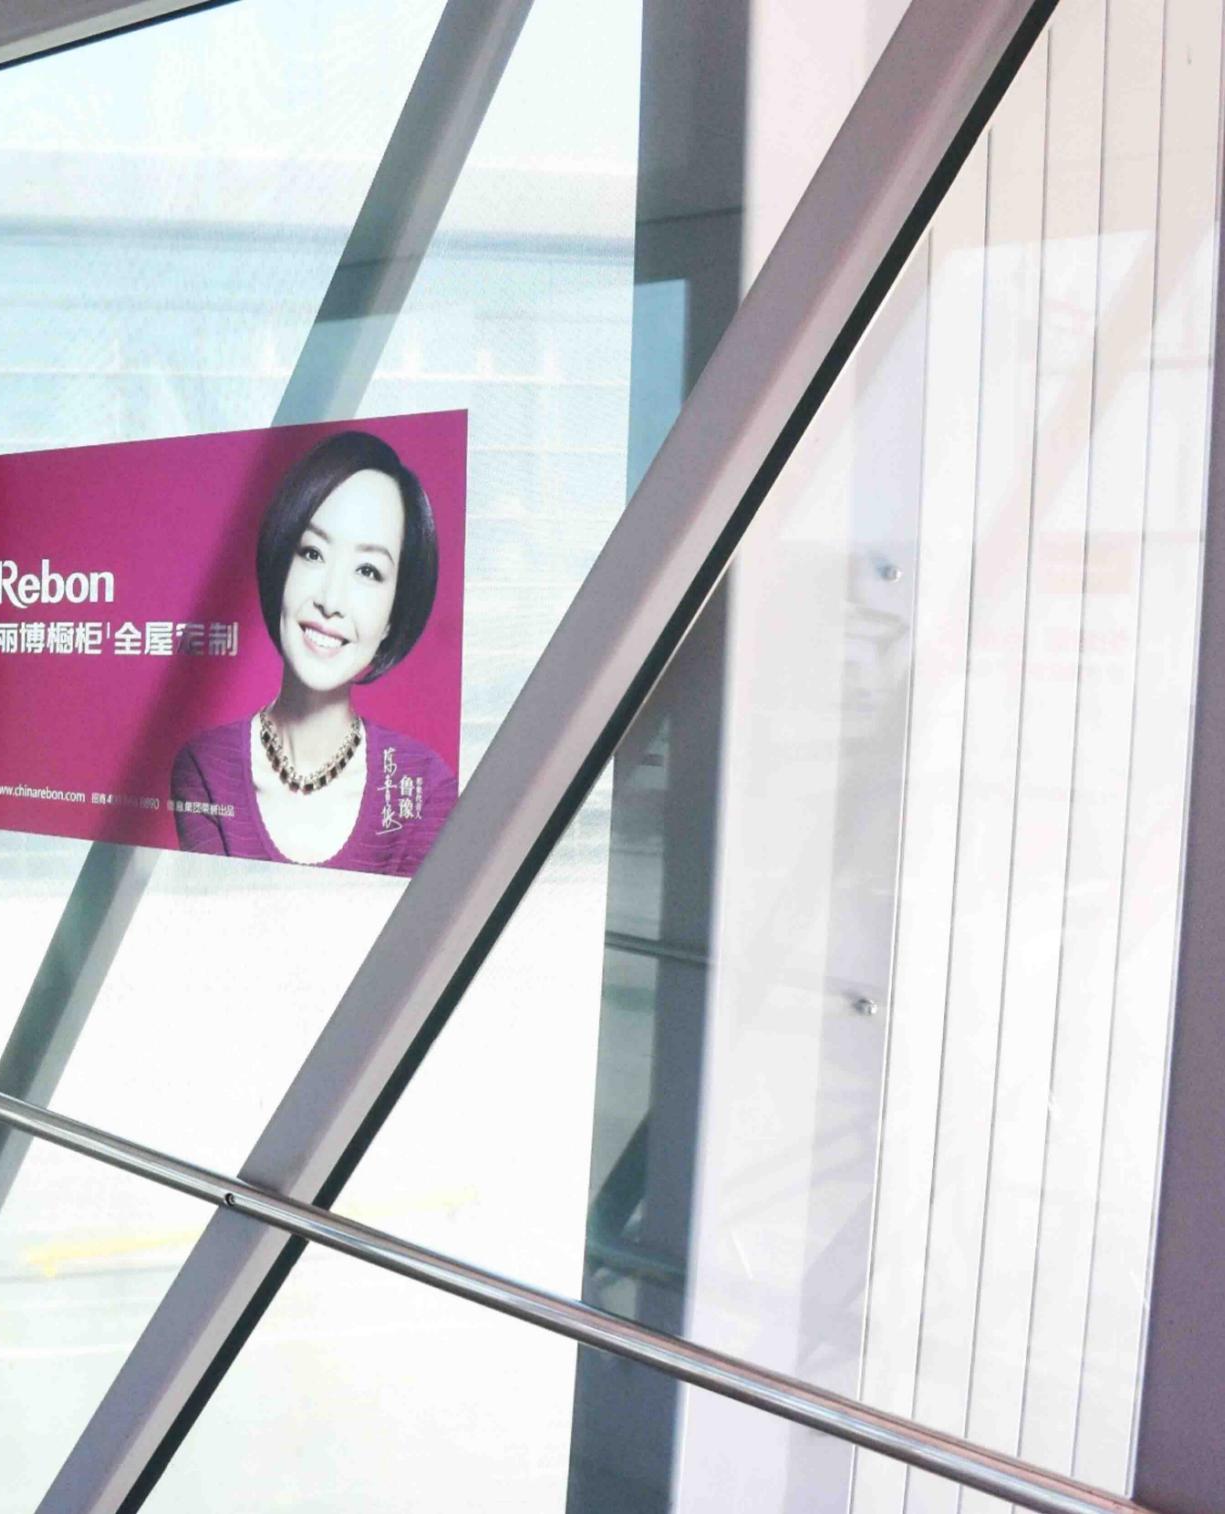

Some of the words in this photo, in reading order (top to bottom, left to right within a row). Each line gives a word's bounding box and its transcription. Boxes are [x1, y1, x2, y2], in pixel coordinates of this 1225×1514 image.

[114, 621, 239, 656] 全屋定制
[399, 774, 414, 819] 鲁豫
